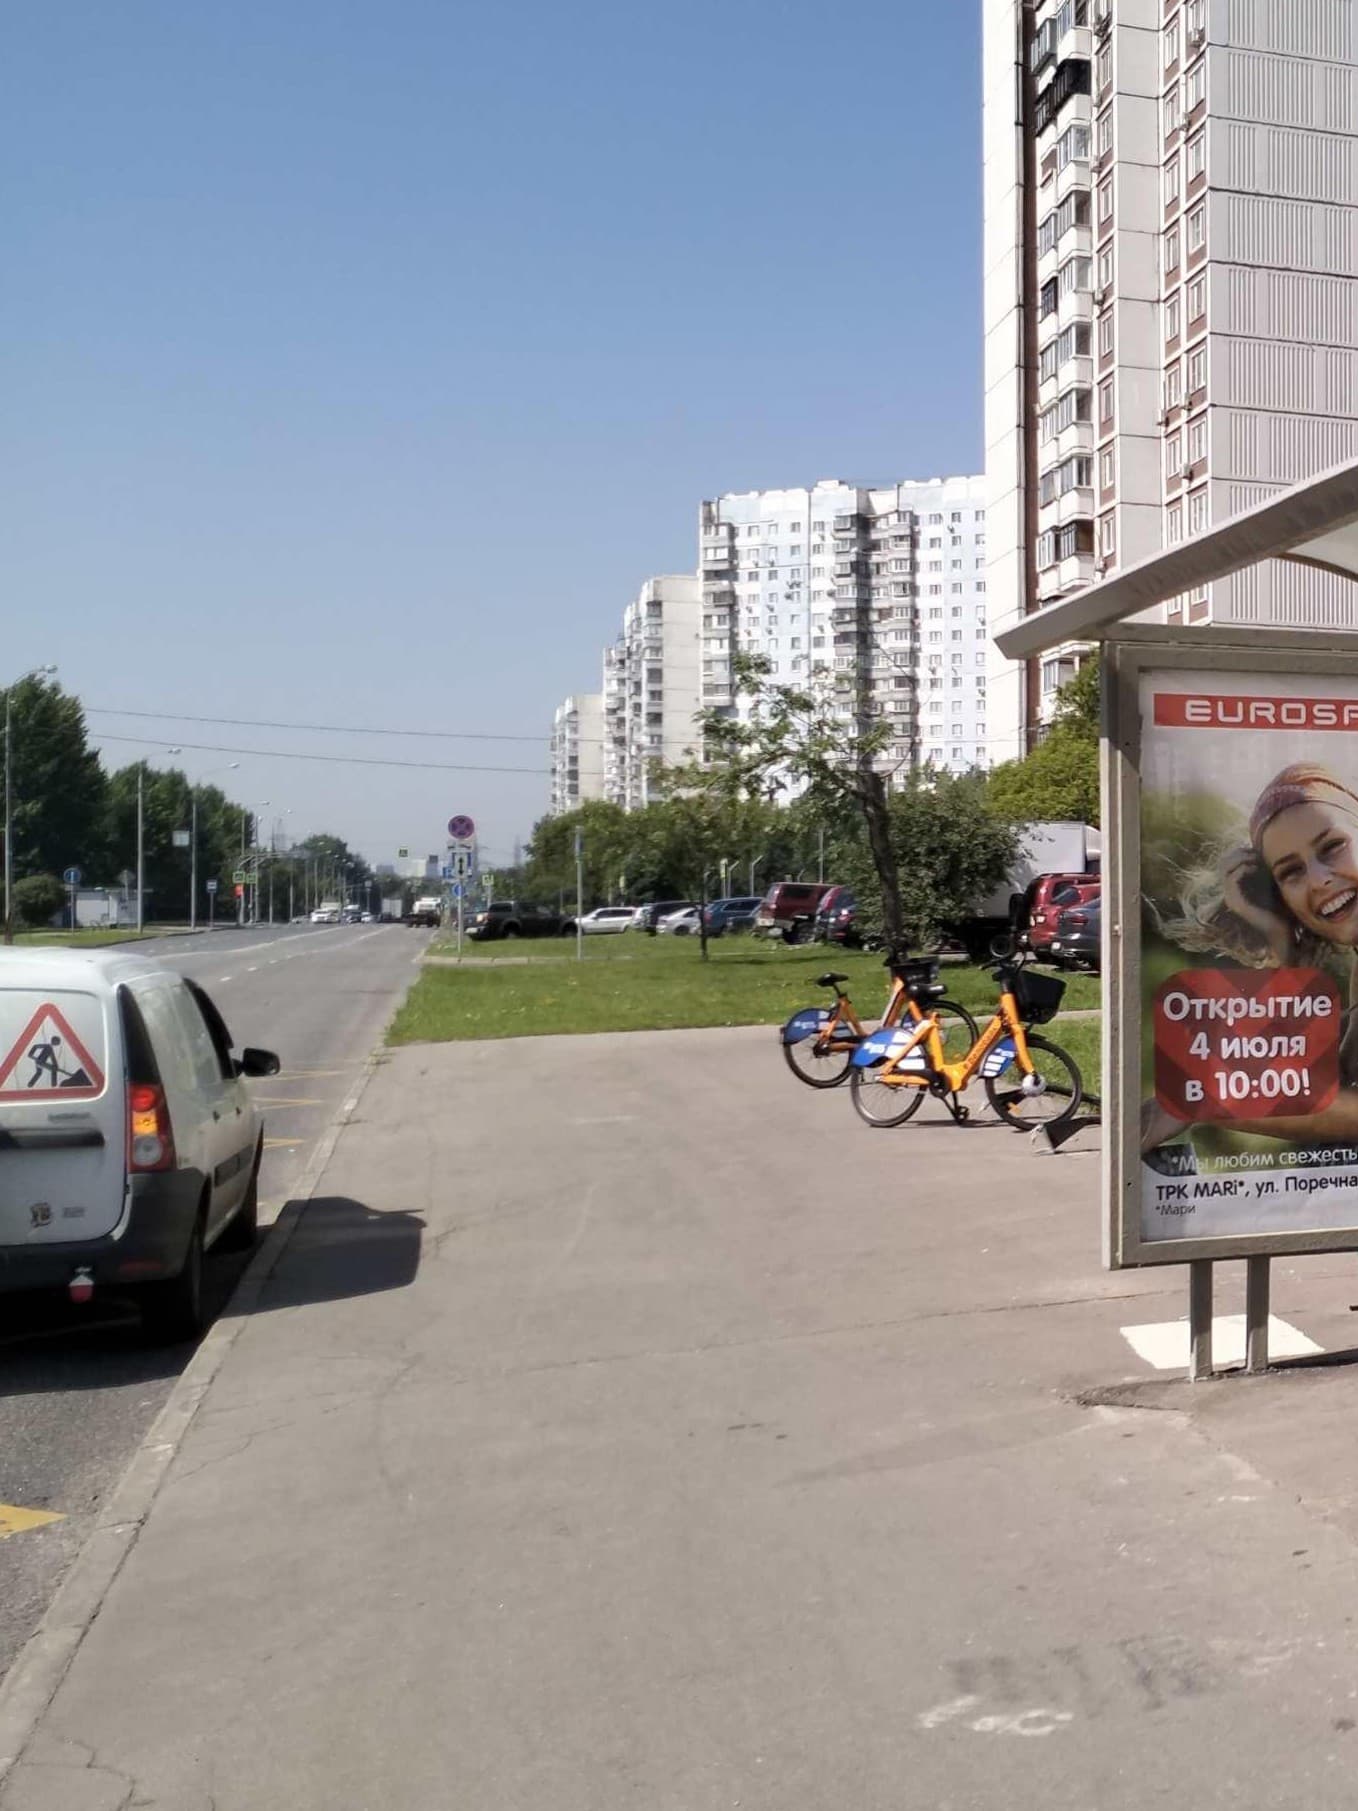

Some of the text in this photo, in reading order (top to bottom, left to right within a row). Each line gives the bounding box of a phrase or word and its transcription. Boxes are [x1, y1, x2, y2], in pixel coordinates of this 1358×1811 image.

[1163, 991, 1332, 1026] Открытие
[1189, 1032, 1306, 1060] 4 июля
[1186, 1069, 1310, 1102] в 10:00!
[1214, 1152, 1274, 1170] любим
[1279, 1148, 1358, 1165] свежесть
[1156, 1184, 1189, 1202] ТРК
[1255, 1181, 1278, 1198] ул.
